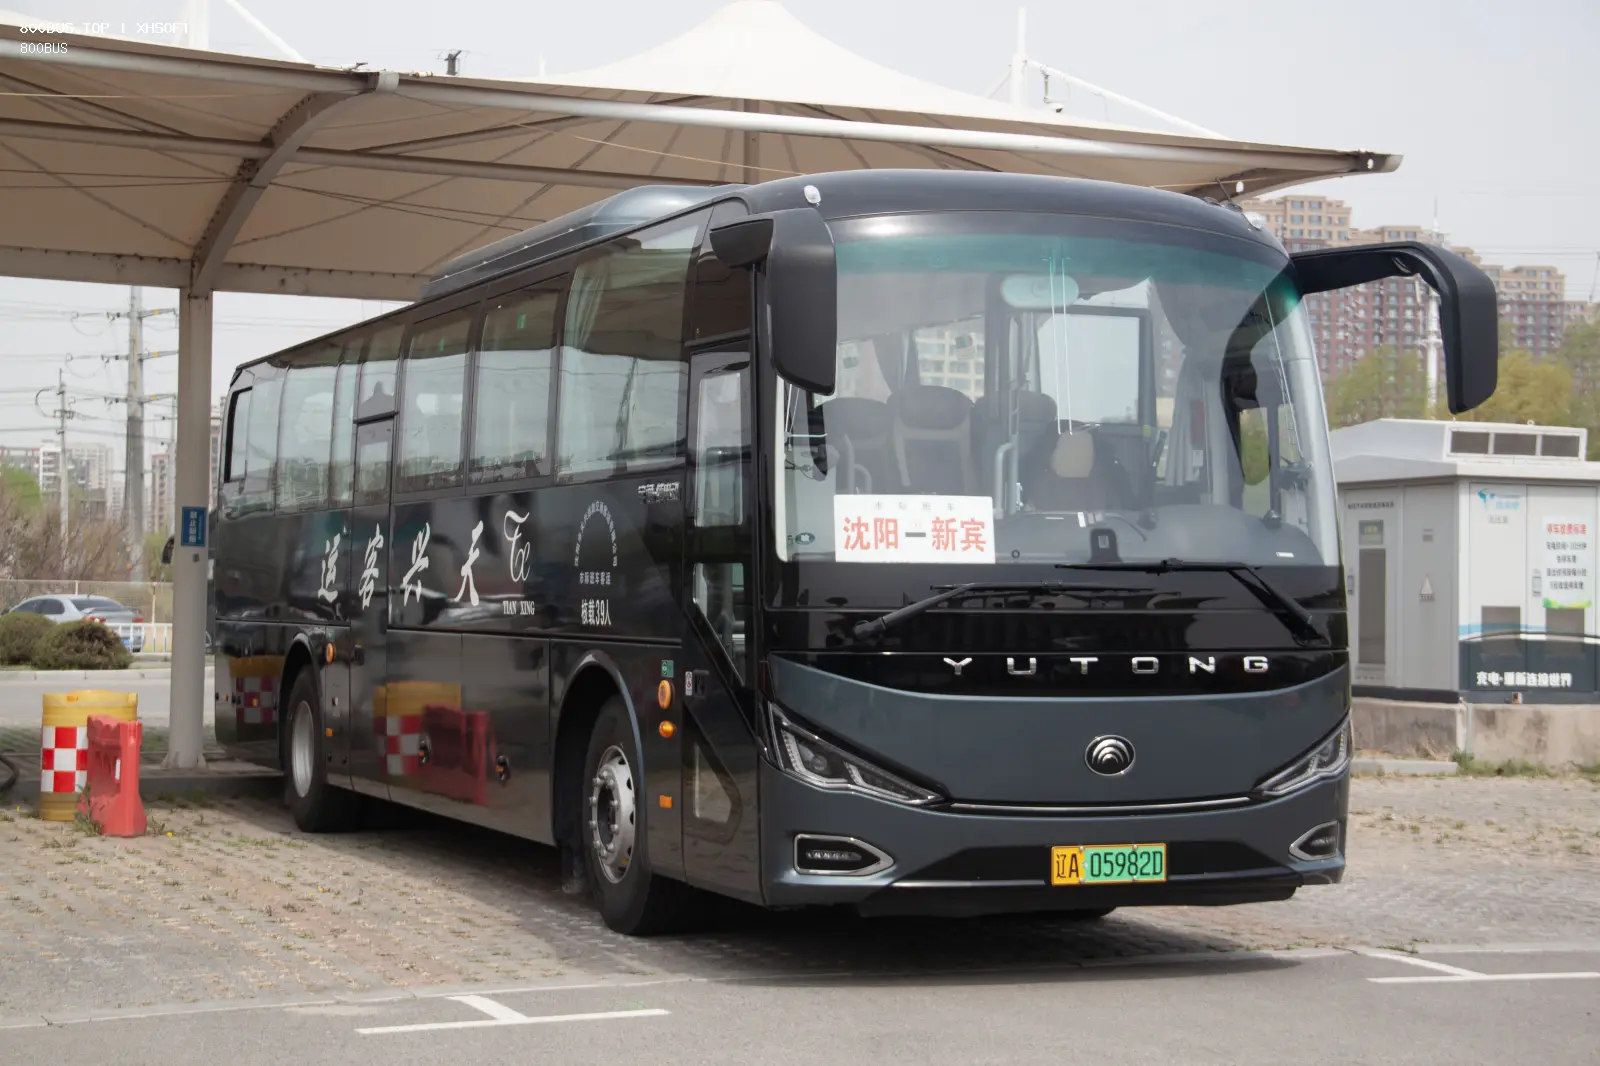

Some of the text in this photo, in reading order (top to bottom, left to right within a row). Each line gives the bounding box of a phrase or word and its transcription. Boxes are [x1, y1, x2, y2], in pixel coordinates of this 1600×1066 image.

[502, 600, 536, 616] TIAN XING
[581, 599, 612, 626] 核载39人
[943, 656, 1269, 676] YUTONG
